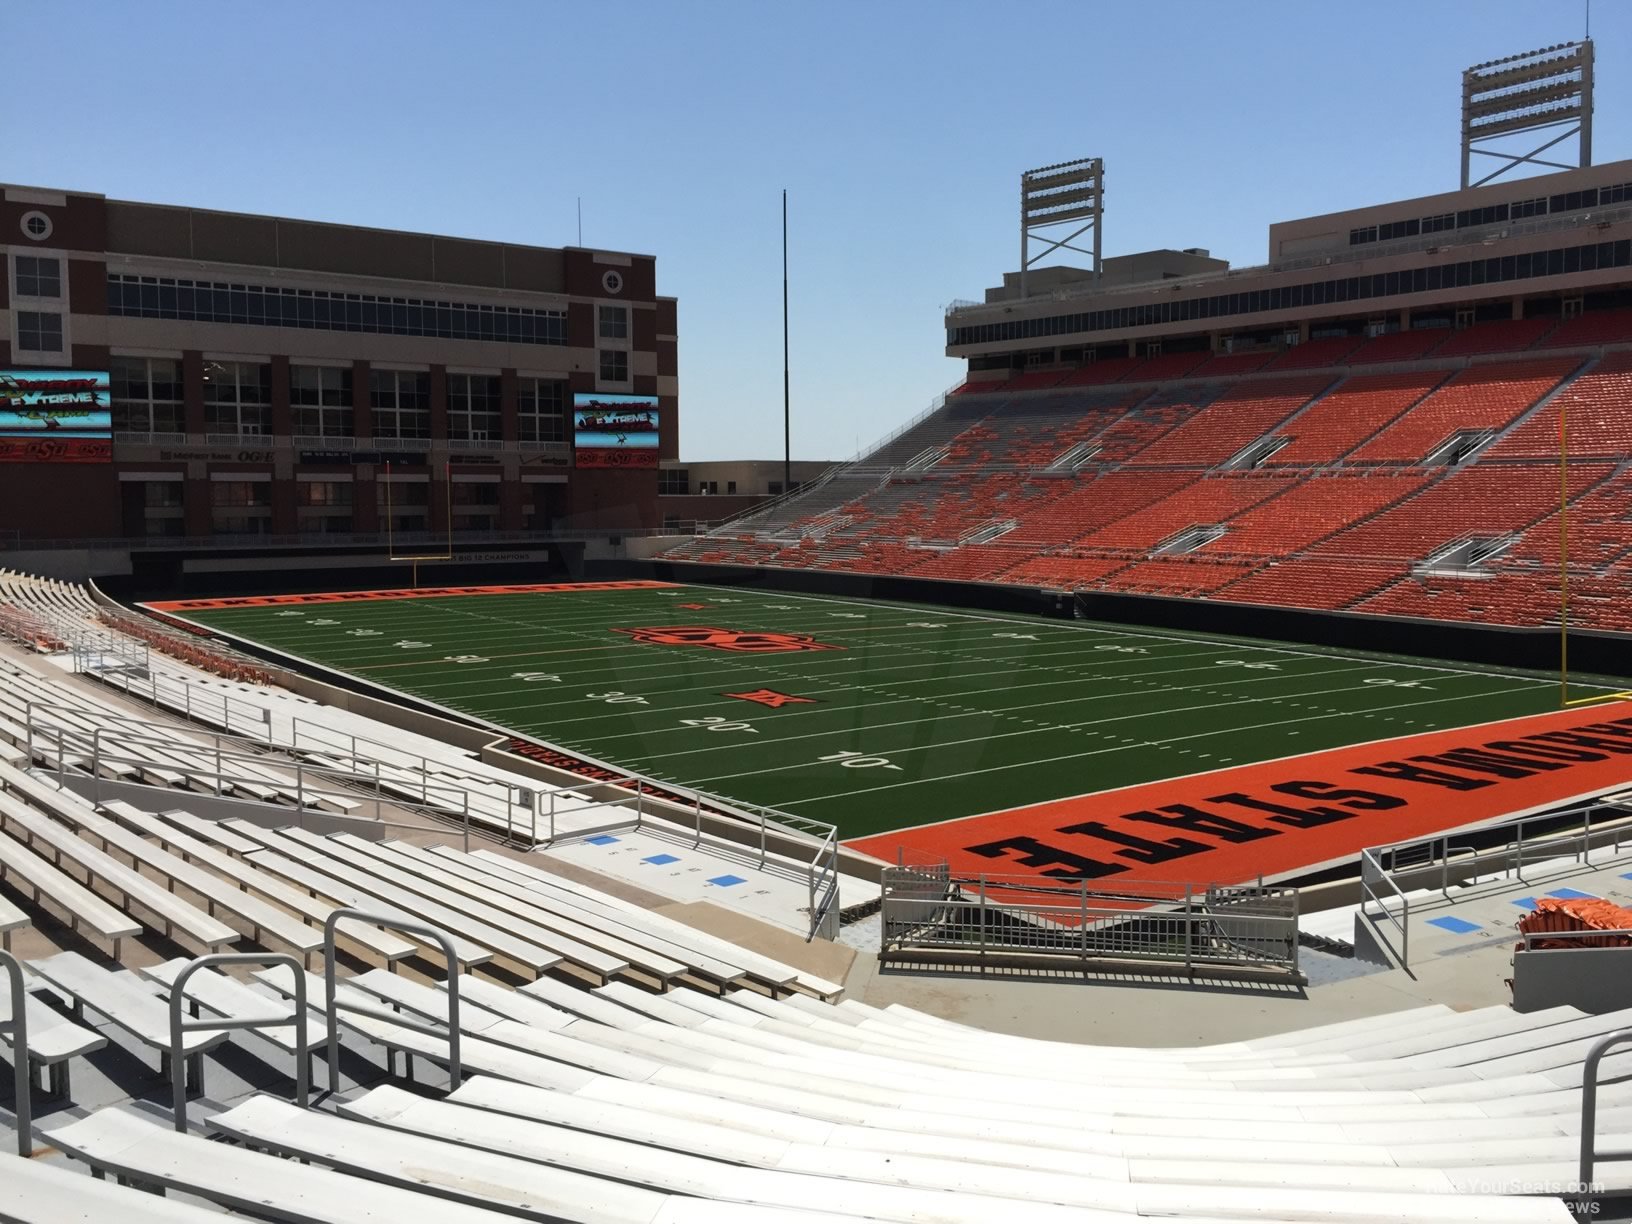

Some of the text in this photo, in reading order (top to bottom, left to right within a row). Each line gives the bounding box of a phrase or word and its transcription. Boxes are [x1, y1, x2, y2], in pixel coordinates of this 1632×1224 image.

[484, 553, 530, 561] CHAMPIONS
[586, 691, 642, 704] 30
[680, 716, 750, 733] 20
[817, 750, 889, 769] 10
[962, 780, 1408, 884] STATE
